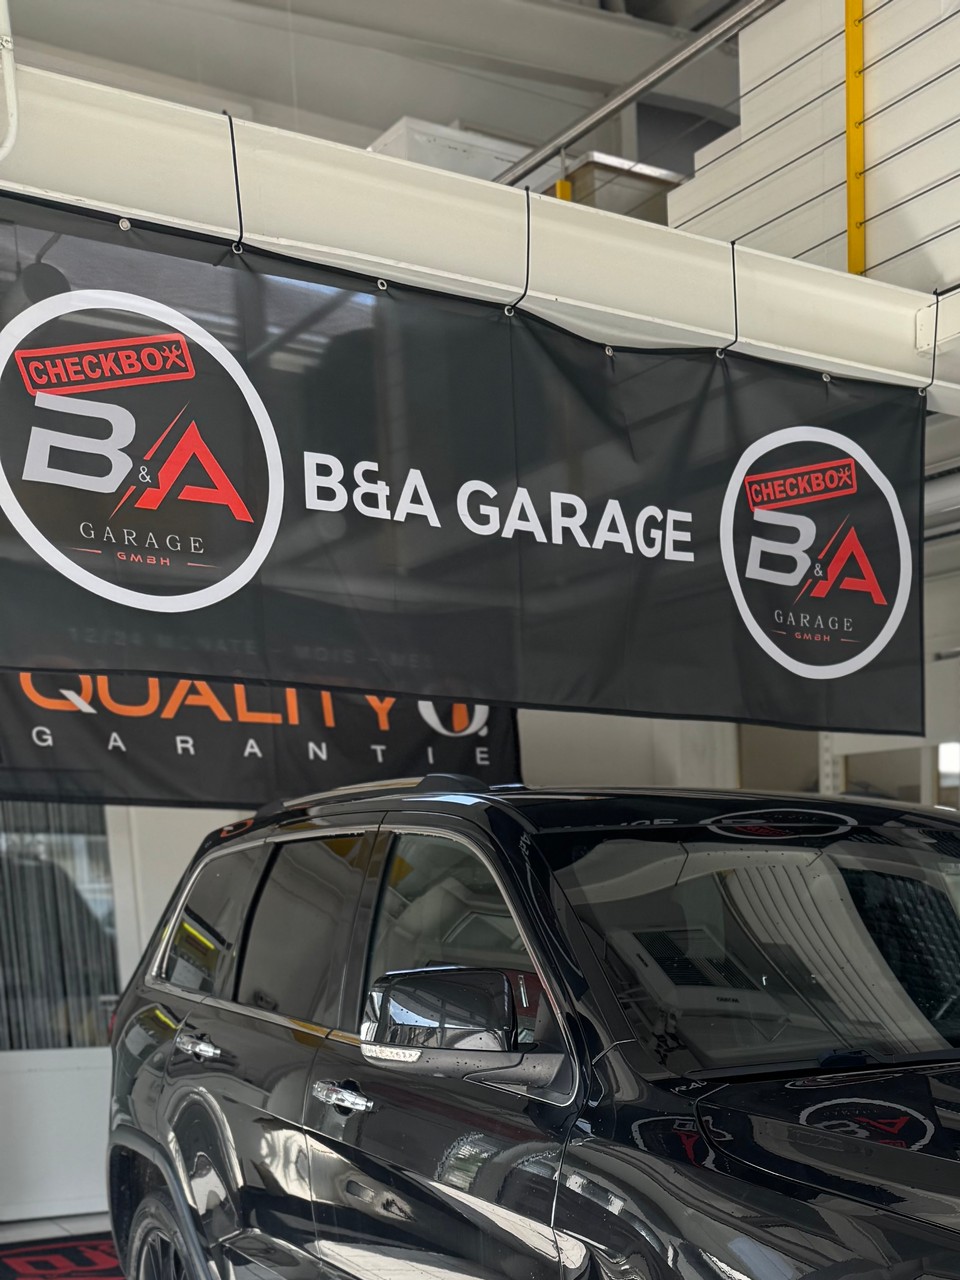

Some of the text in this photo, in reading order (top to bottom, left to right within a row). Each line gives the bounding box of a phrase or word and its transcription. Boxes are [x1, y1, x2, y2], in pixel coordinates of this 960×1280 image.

[27, 344, 186, 385] CHECKBOX
[750, 466, 852, 503] CHECKBOX
[302, 450, 695, 562] B&A GARAGE
[79, 521, 205, 554] GARAGE
[116, 551, 170, 567] GMBH
[774, 609, 853, 632] GARAGE
[794, 632, 831, 642] GMBH
[31, 726, 490, 766] GARANTIE
